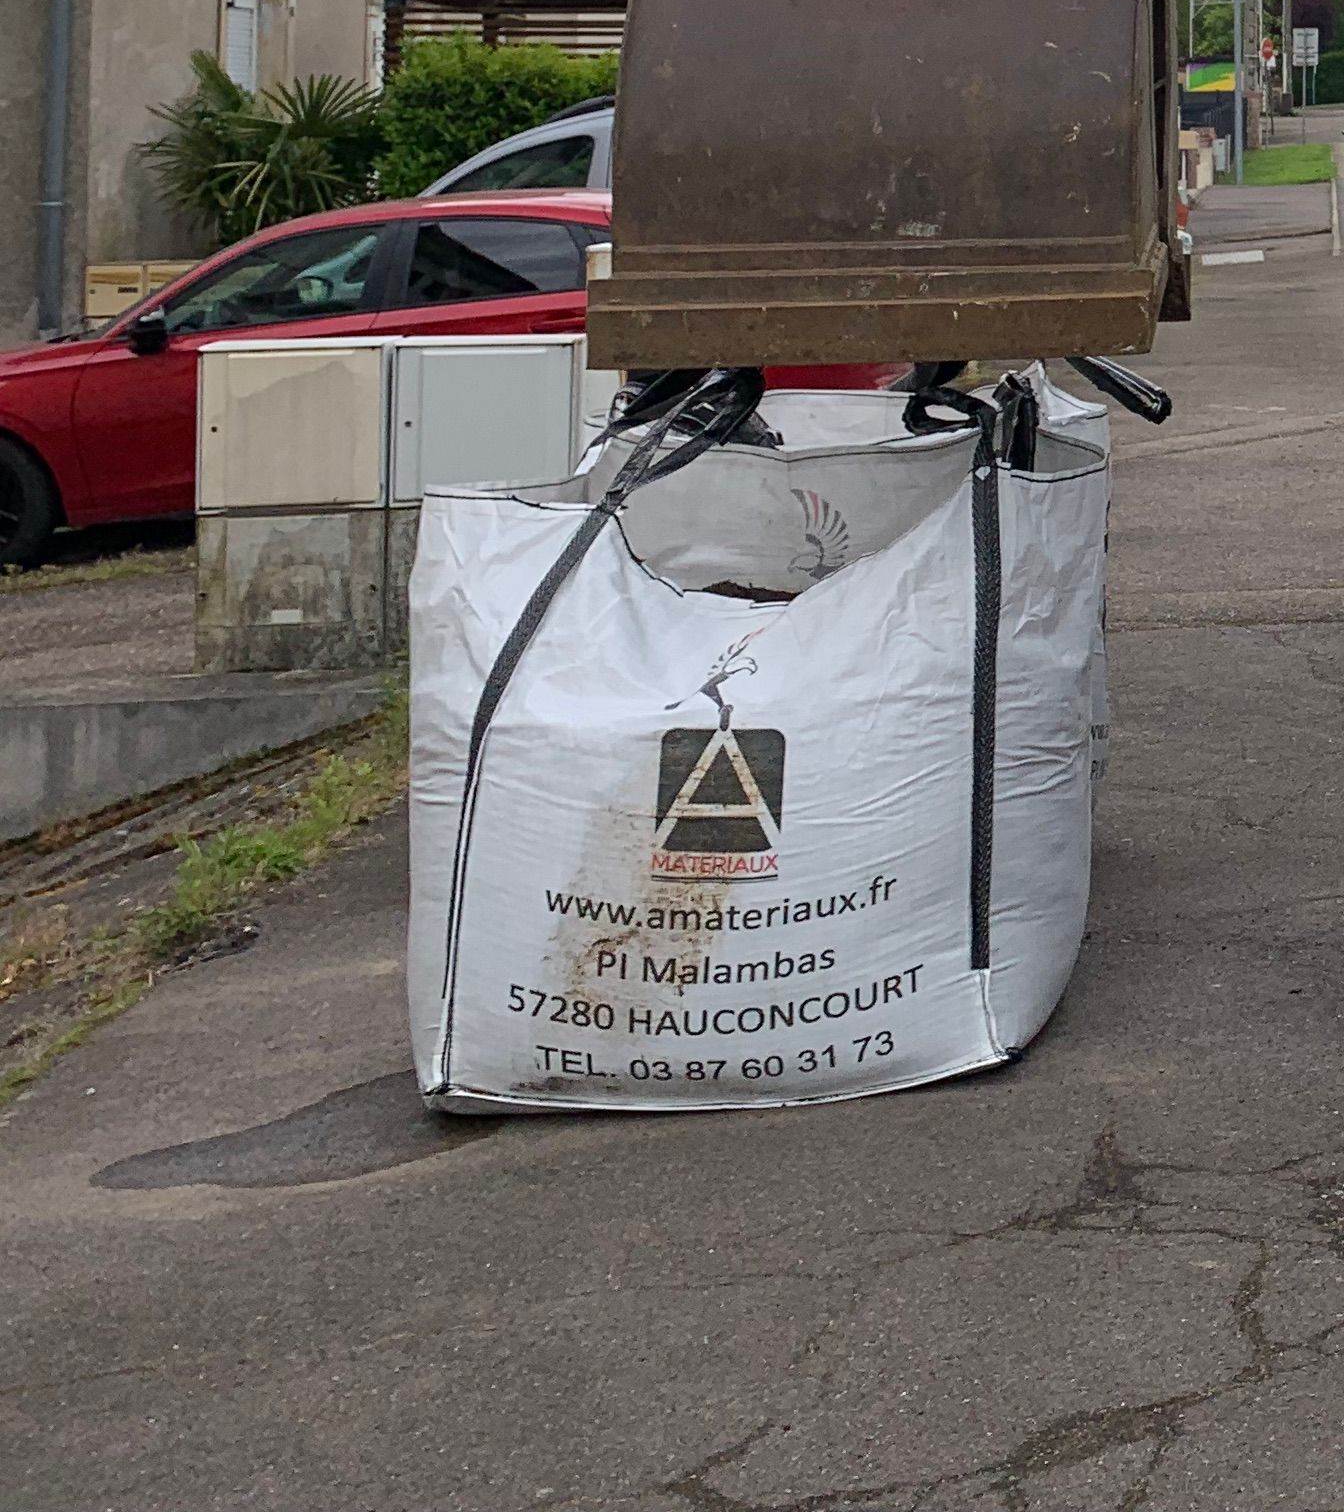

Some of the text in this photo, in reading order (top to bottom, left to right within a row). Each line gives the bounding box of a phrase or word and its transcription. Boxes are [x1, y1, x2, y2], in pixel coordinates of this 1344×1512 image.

[651, 853, 779, 875] MATERIAUX
[545, 874, 898, 932] www.amateriaux.fr
[642, 948, 836, 986] Malambas
[506, 964, 925, 1038] 57280 HAUCONCOURT
[535, 1031, 895, 1081] TEL. 03 87 60 31 73
